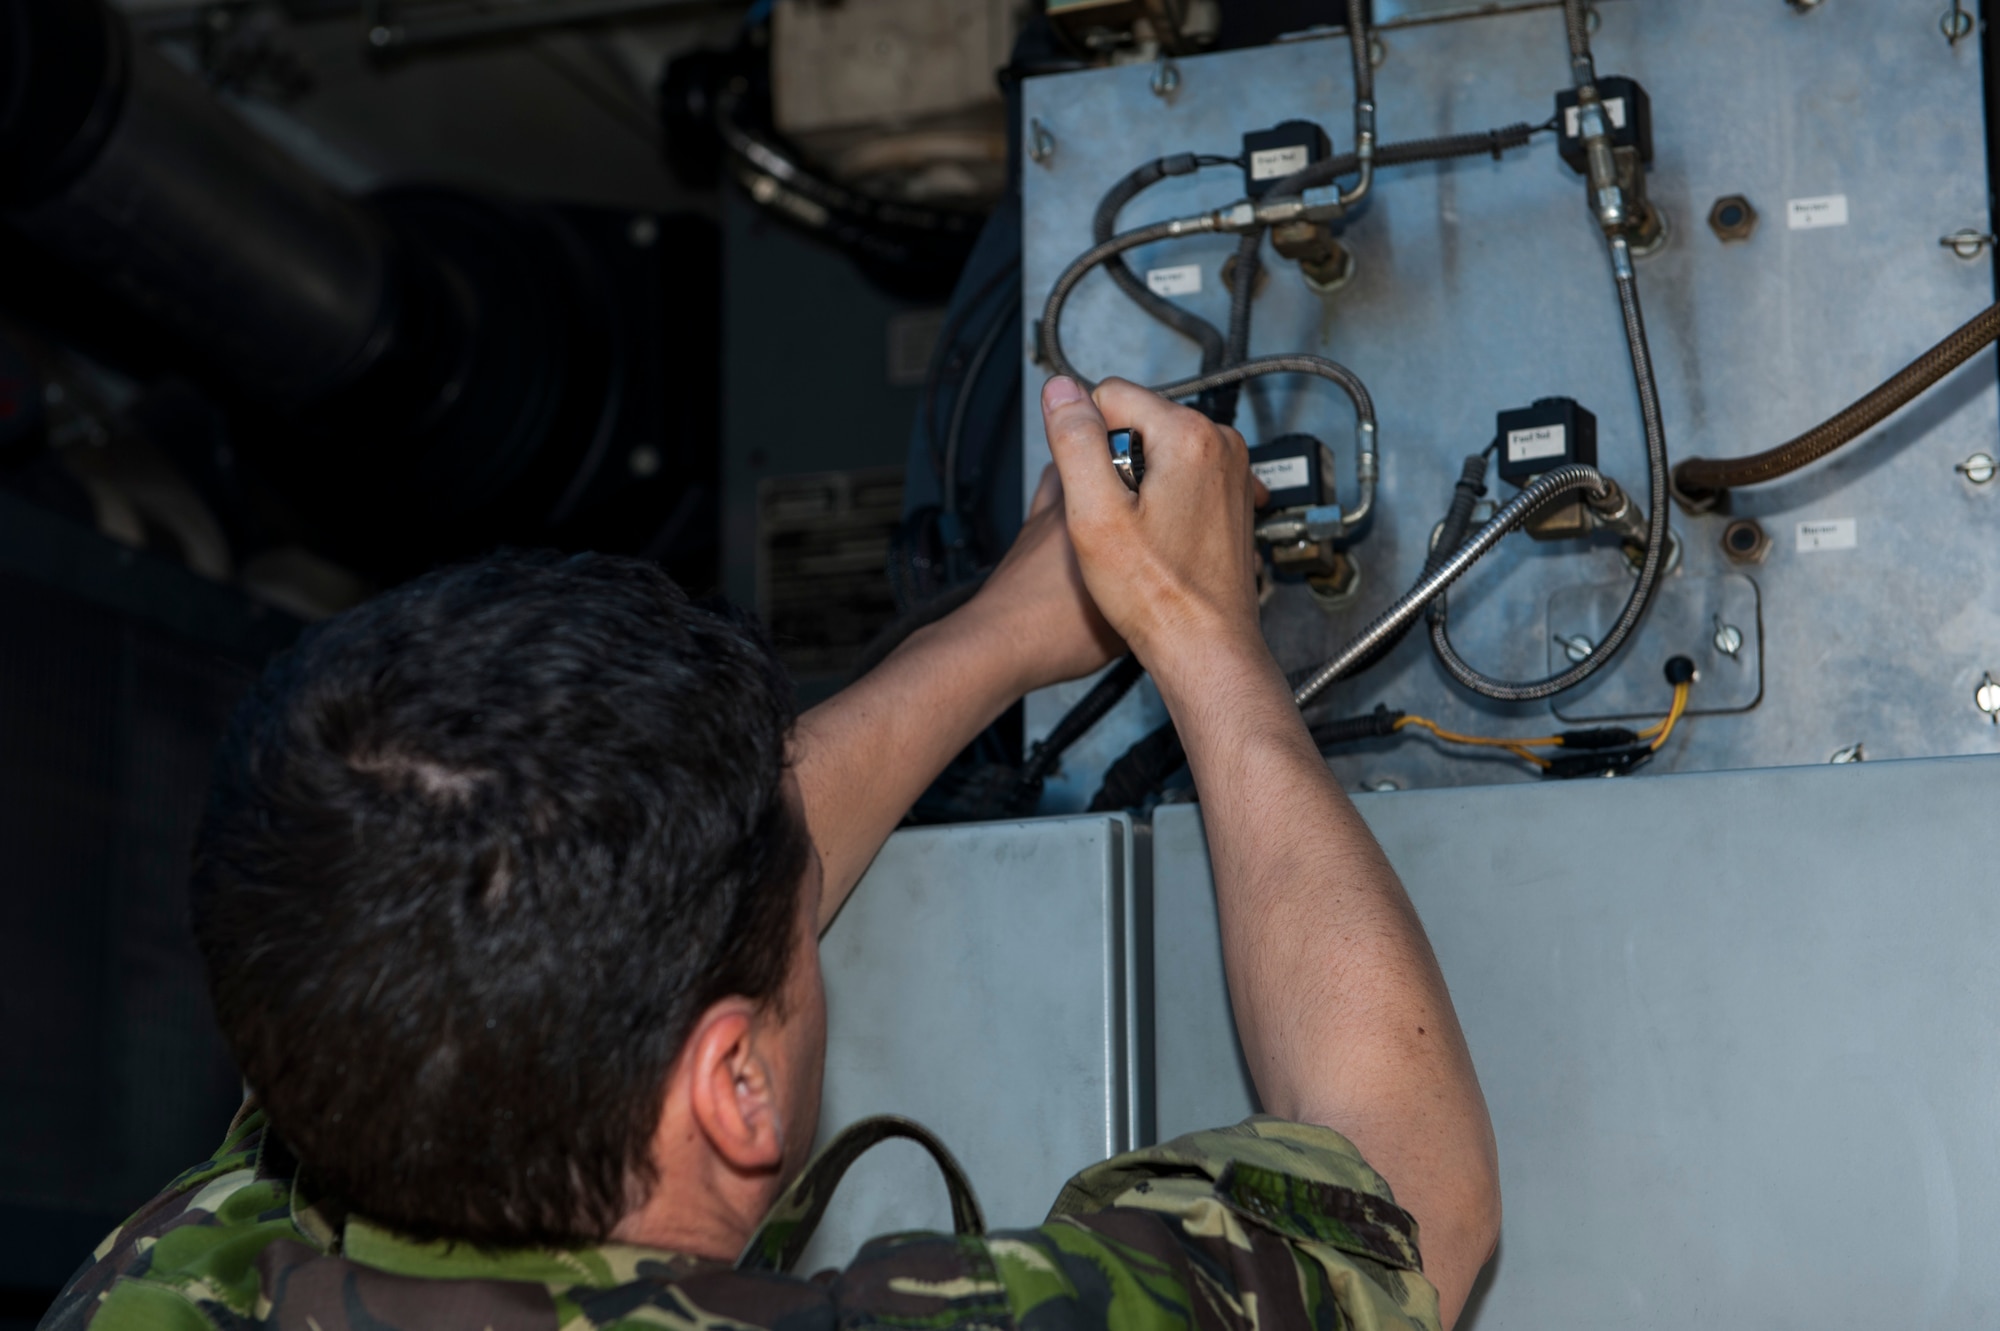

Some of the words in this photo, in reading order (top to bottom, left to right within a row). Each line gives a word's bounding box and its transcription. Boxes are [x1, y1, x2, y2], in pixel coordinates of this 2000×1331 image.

[1513, 432, 1534, 444] Fuel
[1535, 429, 1552, 441] Sol
[1801, 525, 1837, 536] Burner
